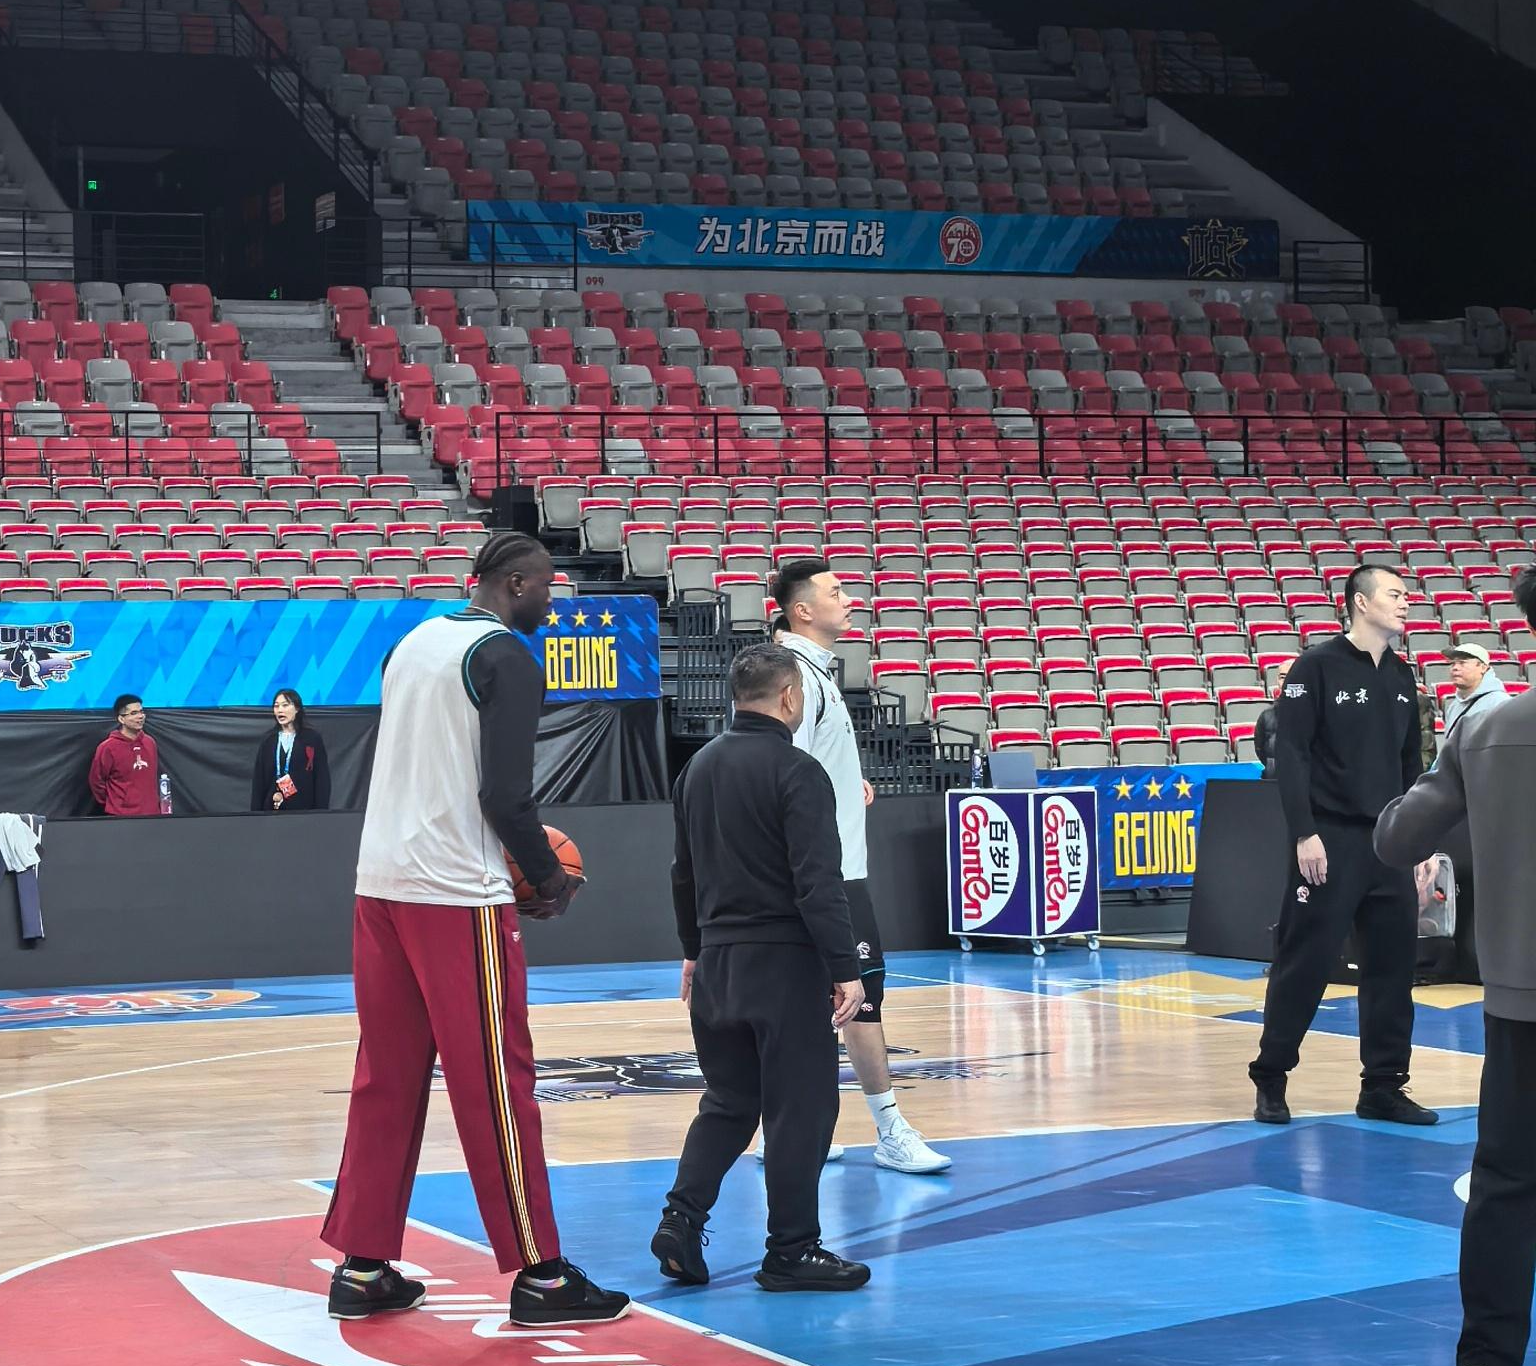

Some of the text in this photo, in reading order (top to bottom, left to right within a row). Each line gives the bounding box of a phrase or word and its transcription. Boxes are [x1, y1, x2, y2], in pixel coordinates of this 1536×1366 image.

[695, 216, 886, 258] 为北京而战
[544, 636, 619, 690] BEIJING
[1335, 688, 1369, 705] 北京
[989, 820, 1010, 895] 百岁山
[1065, 818, 1081, 893] 百岁山
[1113, 809, 1198, 877] BEIJING
